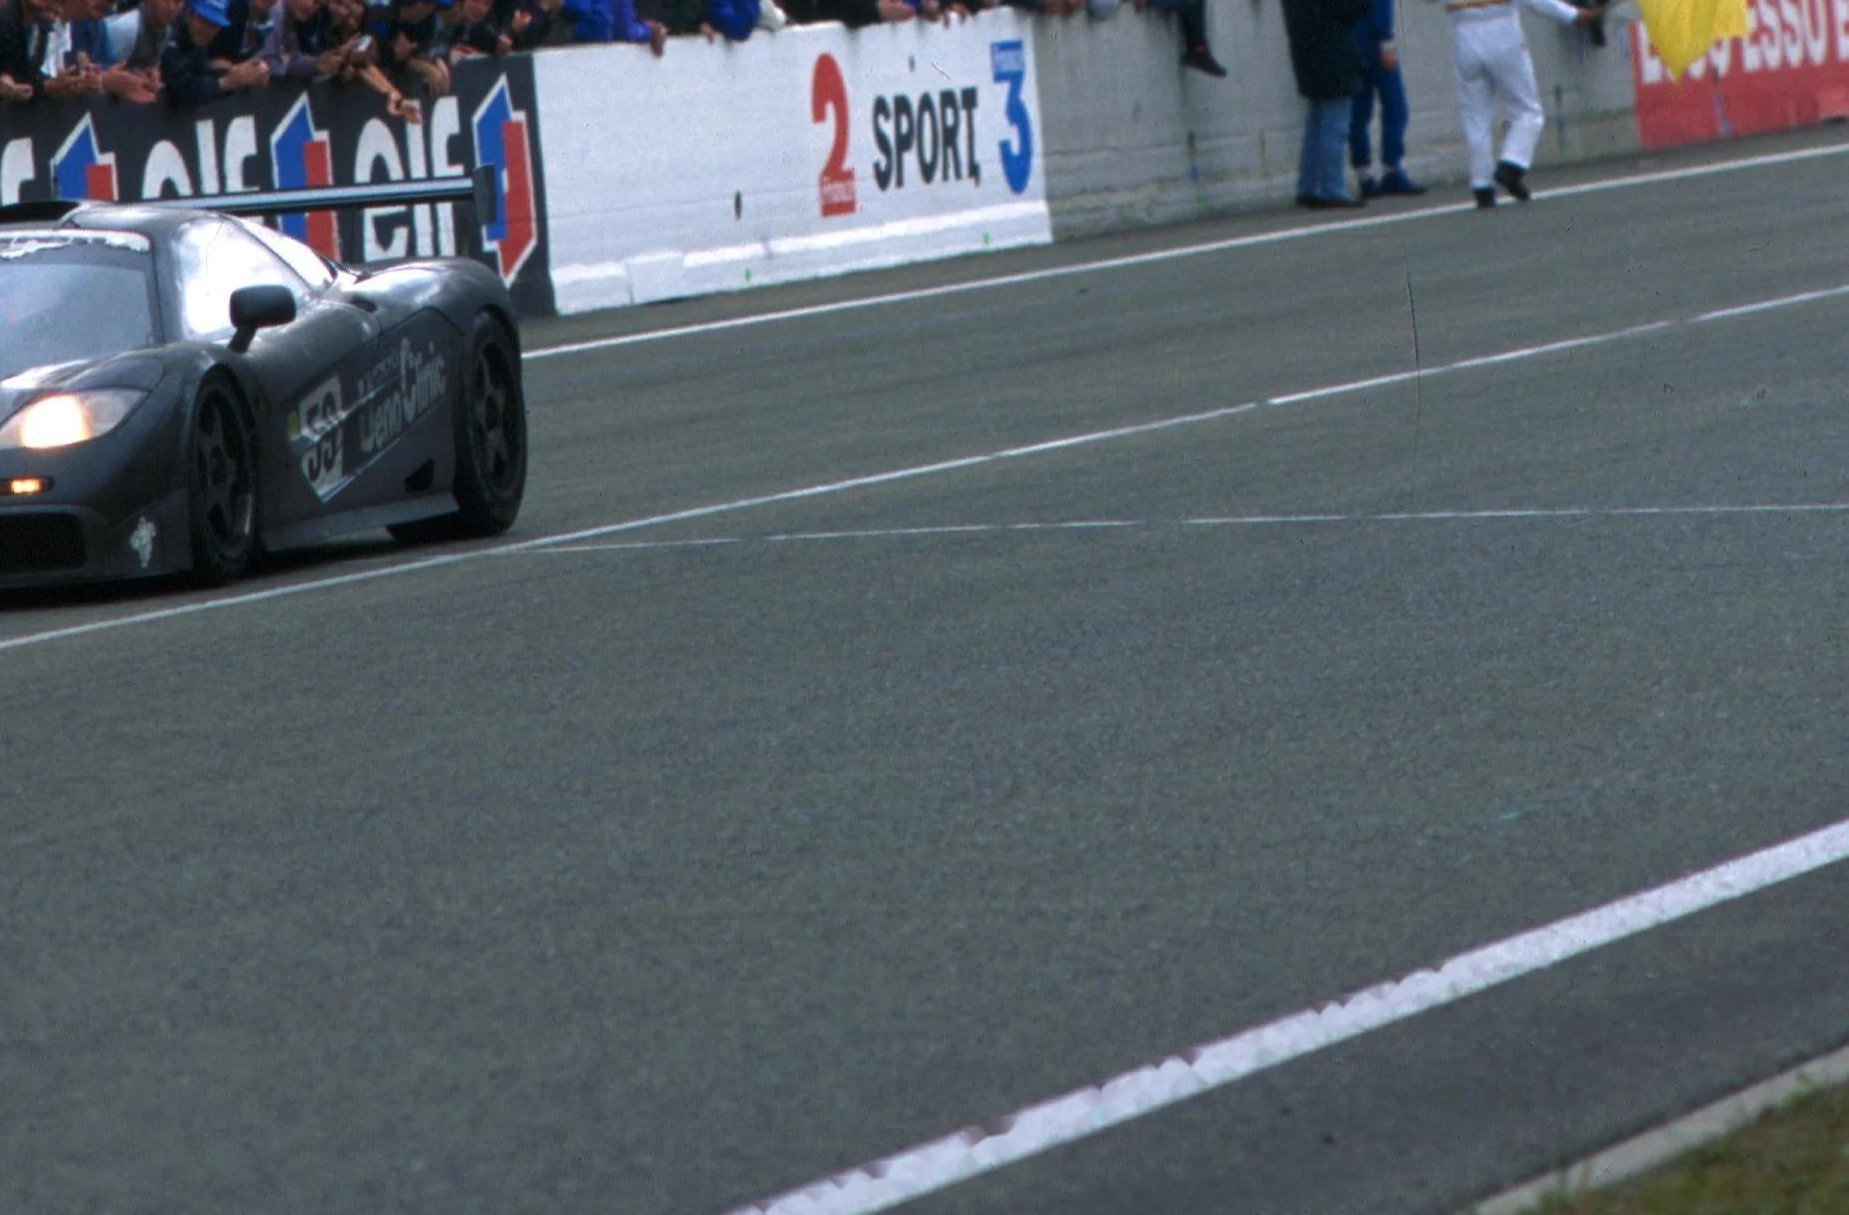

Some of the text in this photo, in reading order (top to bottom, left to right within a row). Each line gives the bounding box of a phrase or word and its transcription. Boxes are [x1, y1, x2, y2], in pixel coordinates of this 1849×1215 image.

[355, 97, 464, 261] elf
[812, 40, 1033, 217] 2 SPORT 3
